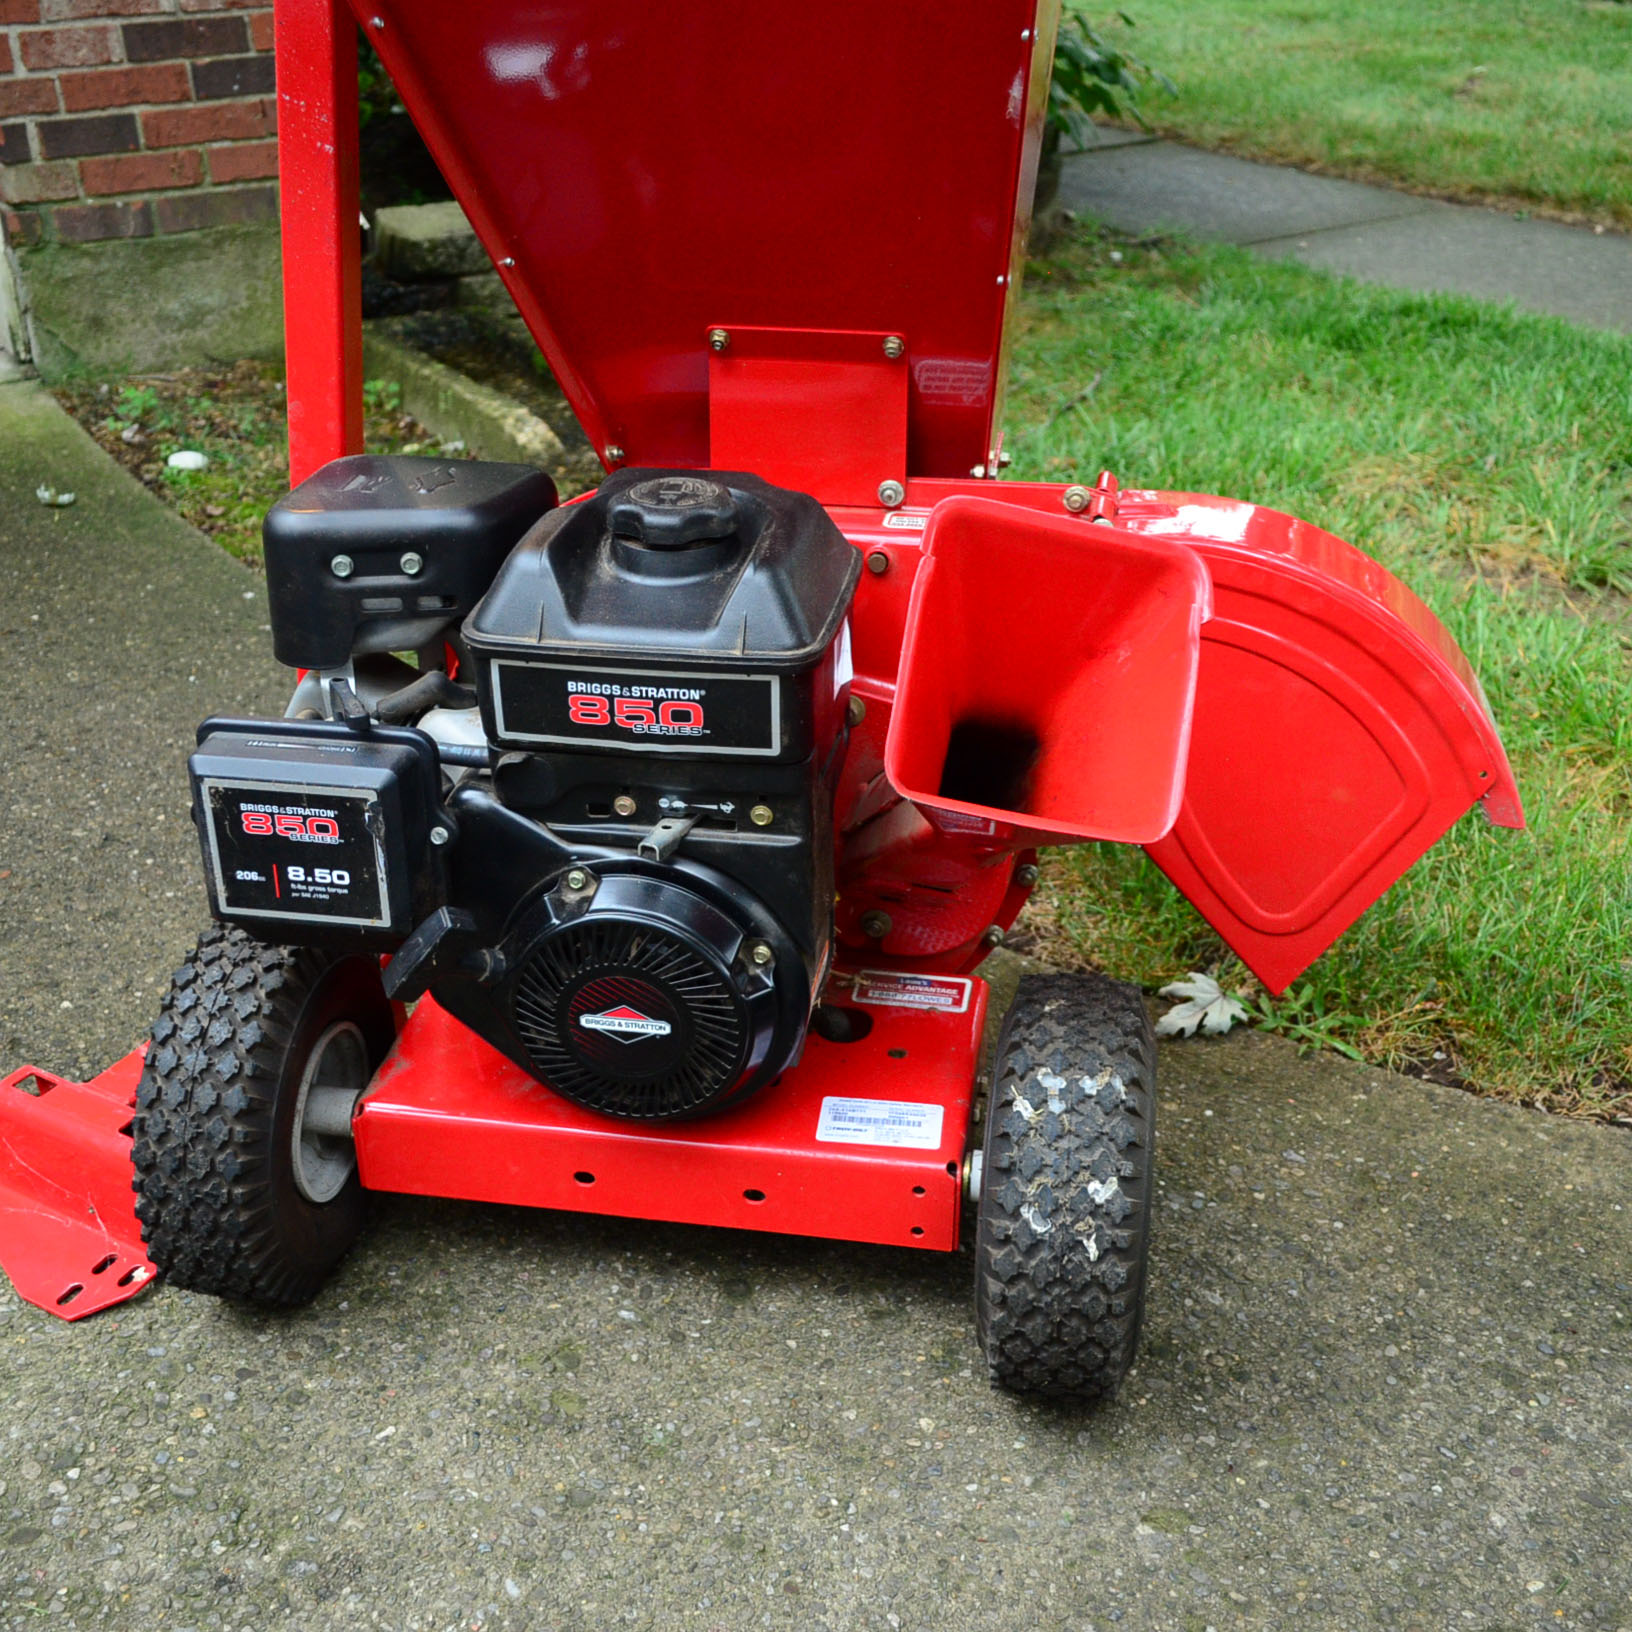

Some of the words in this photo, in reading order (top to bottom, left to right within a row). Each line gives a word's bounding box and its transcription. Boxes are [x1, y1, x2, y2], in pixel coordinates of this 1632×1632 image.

[568, 694, 704, 729] 850
[632, 723, 703, 736] SERIES
[242, 812, 339, 838] 850
[289, 833, 340, 845] SERIES
[287, 866, 351, 886] 8.50
[905, 985, 959, 995] ADVANTAGE
[584, 1017, 617, 1028] BRIGGS
[624, 1021, 667, 1032] STRATTON
